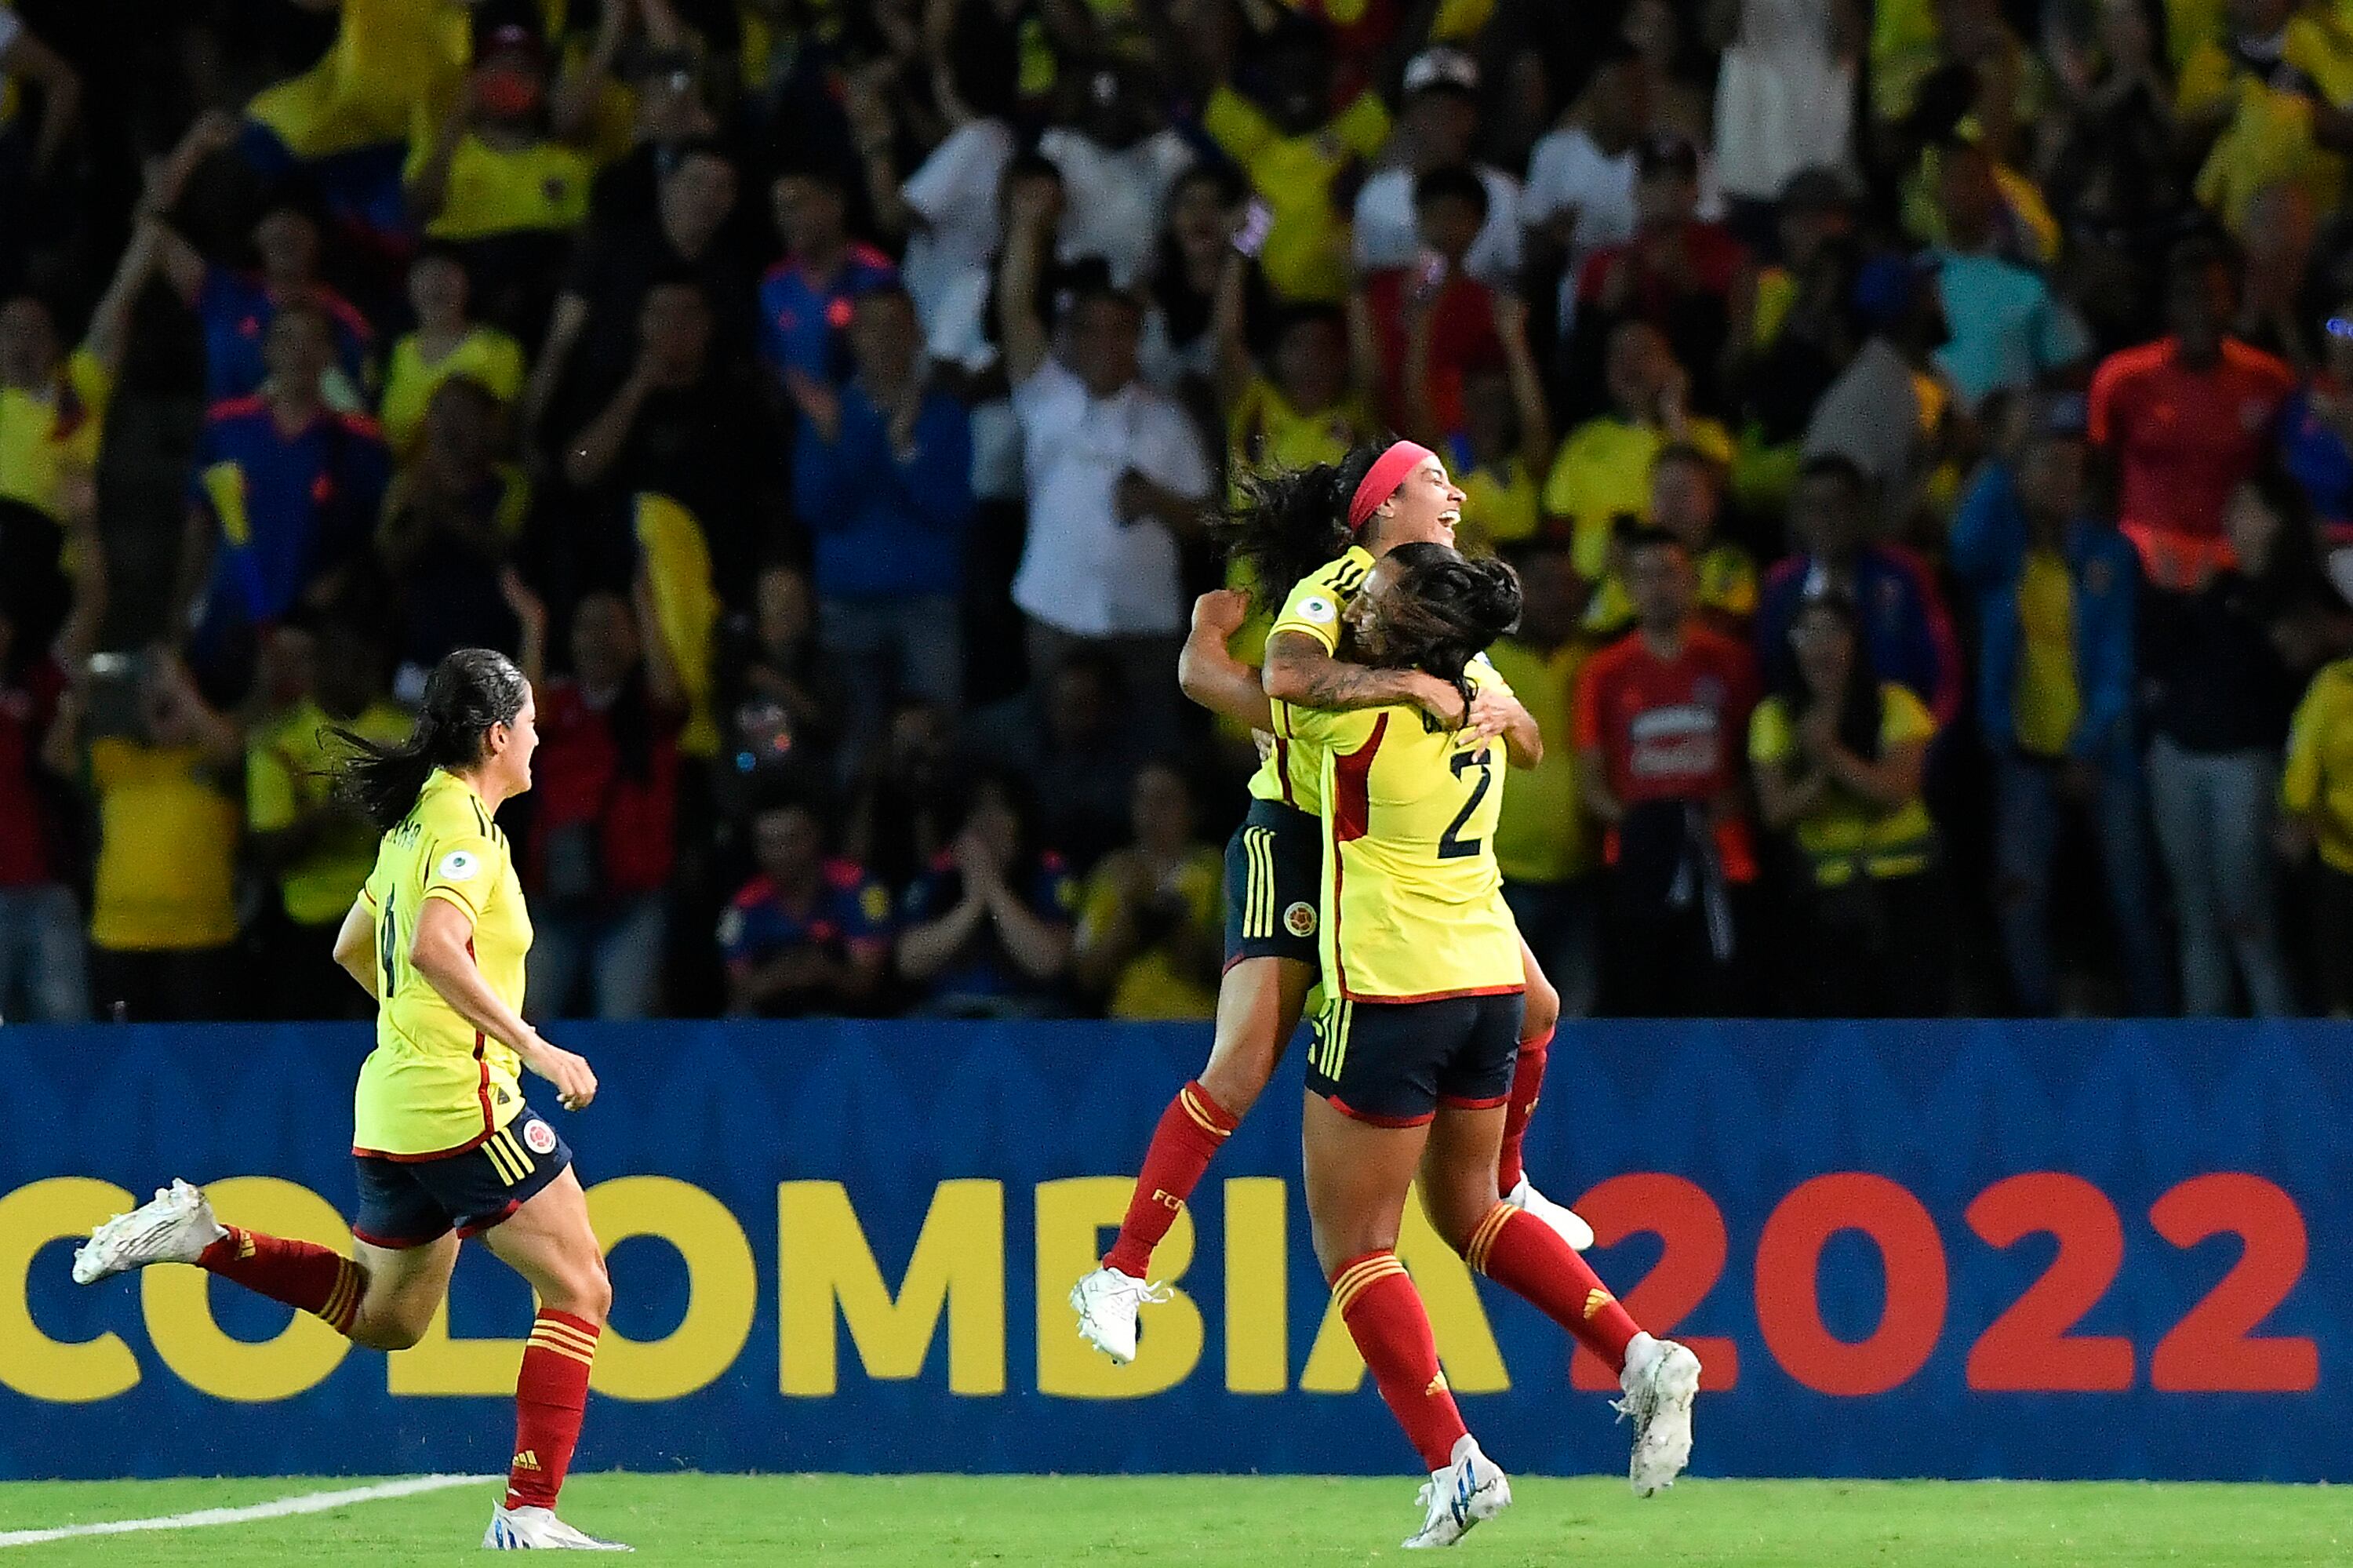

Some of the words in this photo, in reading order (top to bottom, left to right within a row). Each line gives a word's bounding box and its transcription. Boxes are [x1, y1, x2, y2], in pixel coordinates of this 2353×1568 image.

[1438, 748, 1491, 859] 2
[0, 1176, 1511, 1402] COLOMBIA
[1570, 1172, 2318, 1392] 2022
